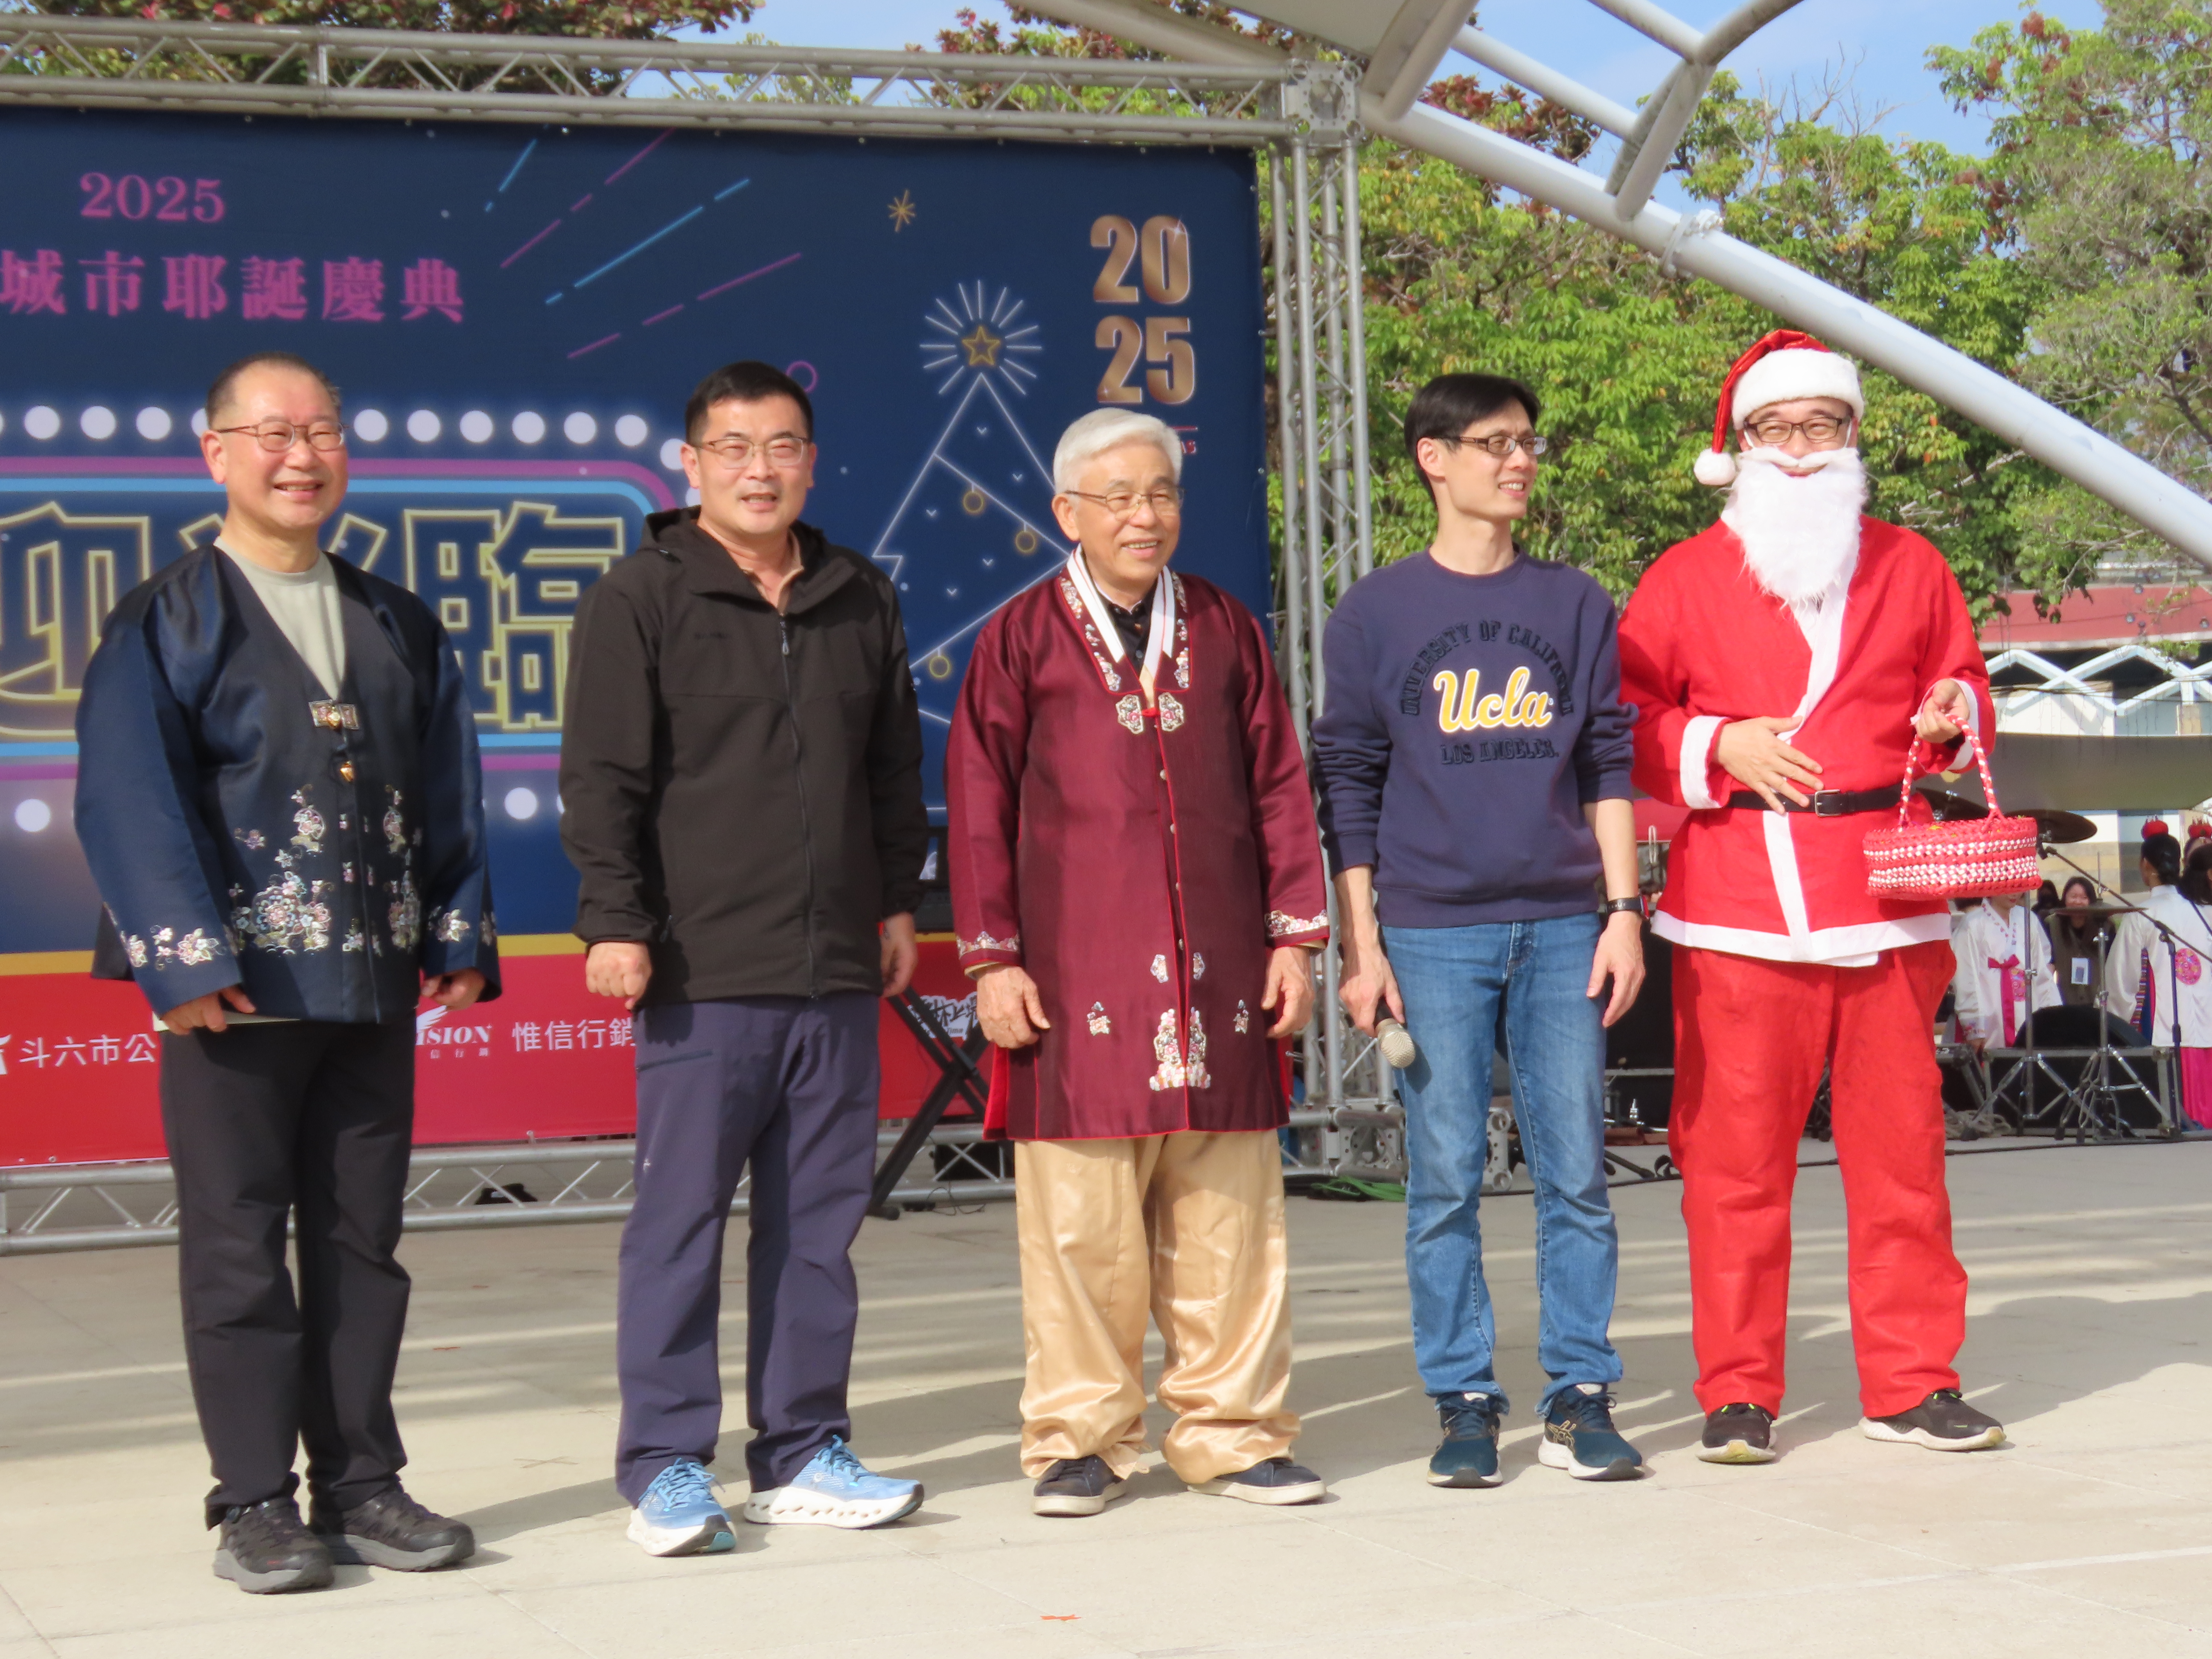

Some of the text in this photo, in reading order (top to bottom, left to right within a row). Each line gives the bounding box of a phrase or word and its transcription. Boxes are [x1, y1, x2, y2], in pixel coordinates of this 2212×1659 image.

[80, 172, 225, 223] 2025
[0, 249, 463, 323] 城市耶誕慶典
[1090, 215, 1191, 305] 20
[1095, 315, 1195, 405] 25
[0, 500, 624, 738] 迎臨
[1400, 622, 1471, 716] UNIVERSITY
[1479, 620, 1502, 641] OF
[1440, 744, 1474, 765] LOS
[19, 1033, 156, 1068] 斗六市公
[415, 1024, 493, 1046] ISION
[512, 1016, 637, 1052] 惟信行銷
